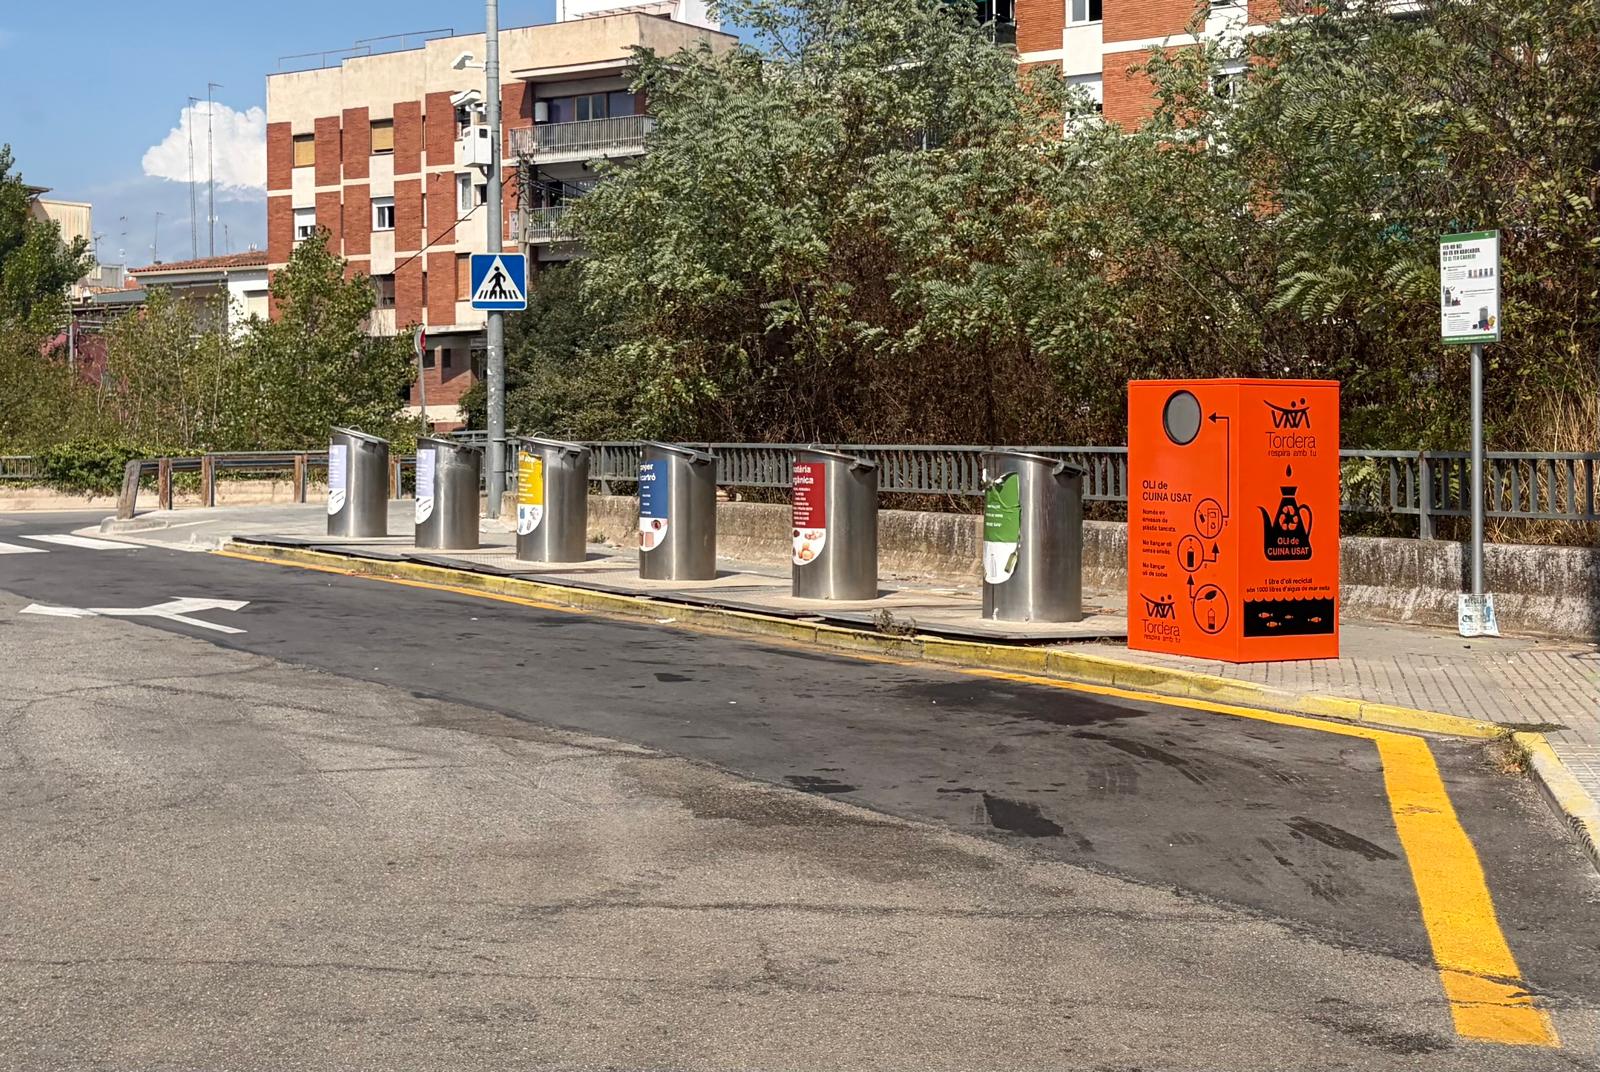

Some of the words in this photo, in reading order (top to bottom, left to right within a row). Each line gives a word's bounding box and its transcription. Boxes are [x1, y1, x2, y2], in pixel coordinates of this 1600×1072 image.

[1265, 432, 1316, 448] Tordera
[1142, 480, 1156, 489] OLI
[1158, 481, 1168, 490] de
[1142, 492, 1168, 501] CUINA
[1170, 493, 1192, 502] USAT
[1291, 547, 1309, 555] USAT
[1141, 619, 1180, 636] Tordera
